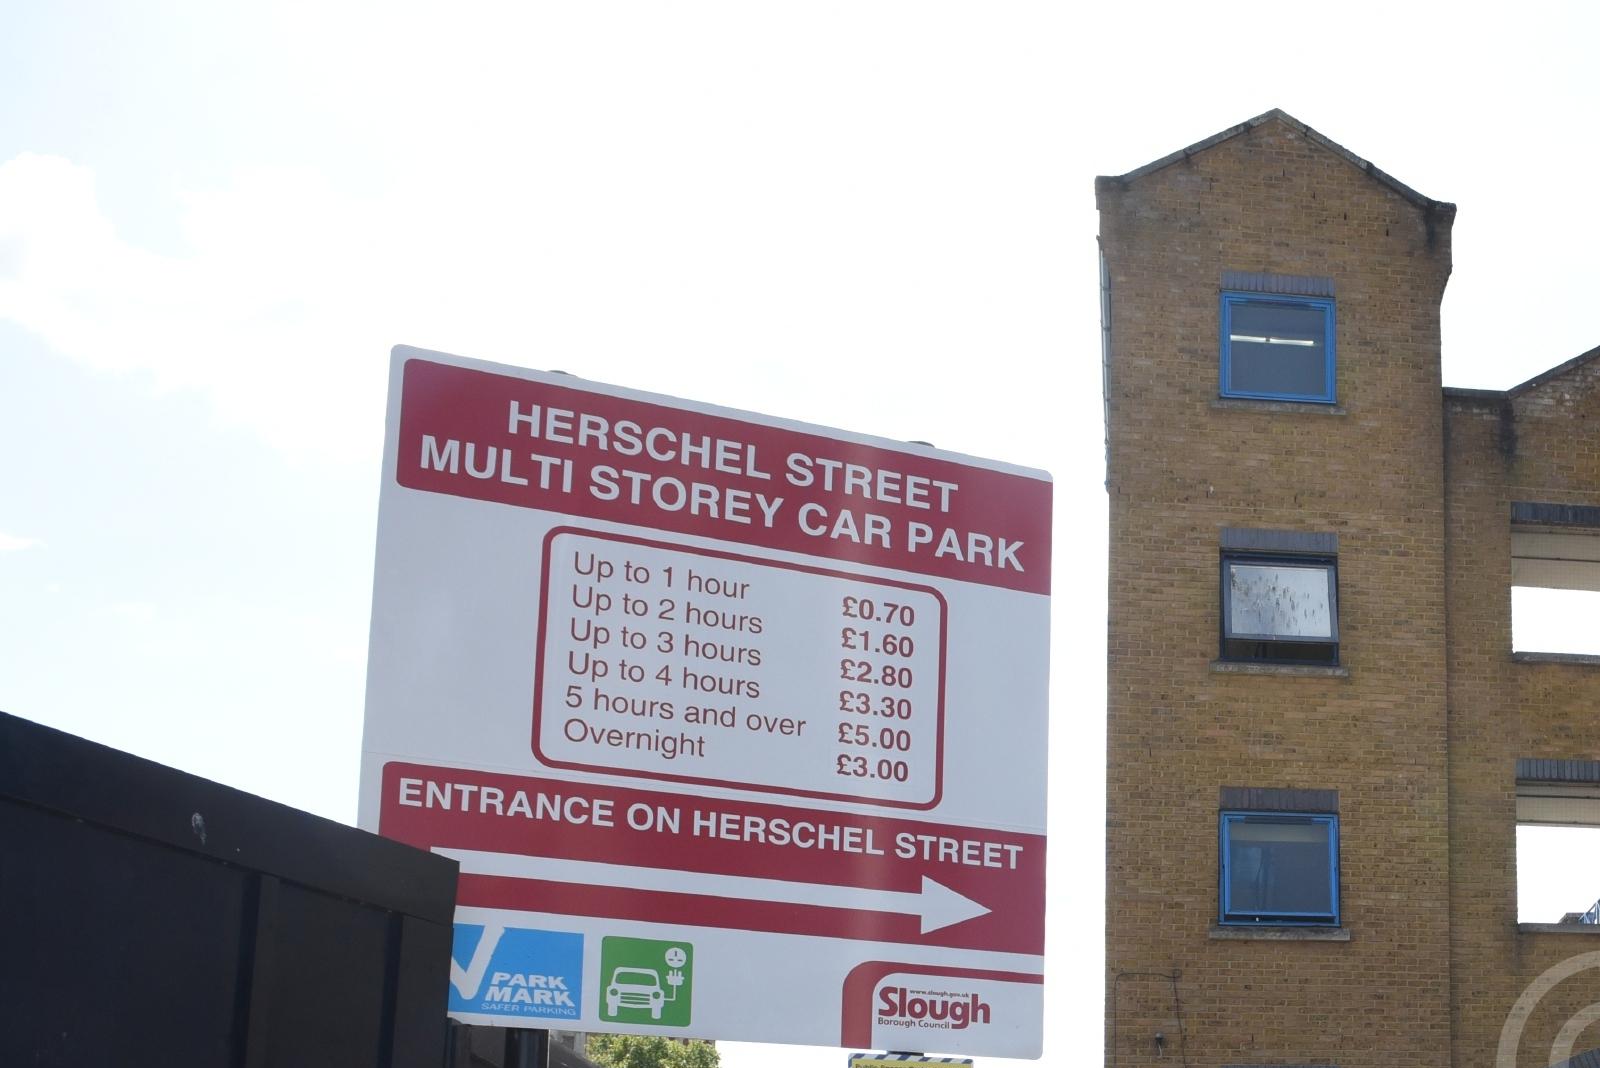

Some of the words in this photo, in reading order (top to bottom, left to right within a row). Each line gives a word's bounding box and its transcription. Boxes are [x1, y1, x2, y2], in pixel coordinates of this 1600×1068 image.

[508, 400, 771, 481] HERSCHEL
[785, 452, 959, 513] STREET
[420, 434, 573, 493] MULTI
[588, 465, 784, 528] STOREY
[798, 502, 891, 549] CAR
[907, 521, 1025, 573] PARK
[572, 584, 612, 616] Up
[622, 593, 648, 617] to
[658, 598, 675, 621] 2
[685, 601, 763, 634] hours
[841, 627, 914, 658] £1.60
[574, 551, 614, 583] Up
[624, 560, 650, 584] to
[663, 566, 673, 588] 1
[687, 569, 750, 600] hour
[842, 596, 915, 627] £0.70
[568, 650, 608, 683] Up
[619, 659, 645, 683] to
[655, 664, 673, 686] 4
[683, 666, 760, 699] hours
[839, 690, 912, 720] £3.30
[570, 617, 610, 649] Up
[620, 626, 647, 650] to
[657, 631, 674, 654] 3
[684, 634, 762, 666] hours
[840, 658, 913, 689] £2.80
[564, 718, 705, 760] Overnight
[836, 753, 909, 782] £3.00
[565, 685, 582, 708] 5
[593, 687, 674, 720] hours
[684, 706, 736, 728] and
[746, 713, 806, 736] over
[838, 722, 911, 752] £5.00
[399, 777, 615, 827] ENTRANCE
[626, 802, 681, 834] ON
[693, 810, 885, 856] HERSCHEL
[895, 832, 1024, 870] STREET
[481, 1002, 520, 1012] SAFER
[523, 1005, 577, 1016] PARKING
[484, 986, 576, 1007] MARK
[490, 971, 568, 990] PARK
[878, 986, 991, 1030] Slough
[909, 989, 970, 999] www.slough.gov.uk
[877, 1017, 916, 1028] Borough
[918, 1019, 950, 1030] Council
